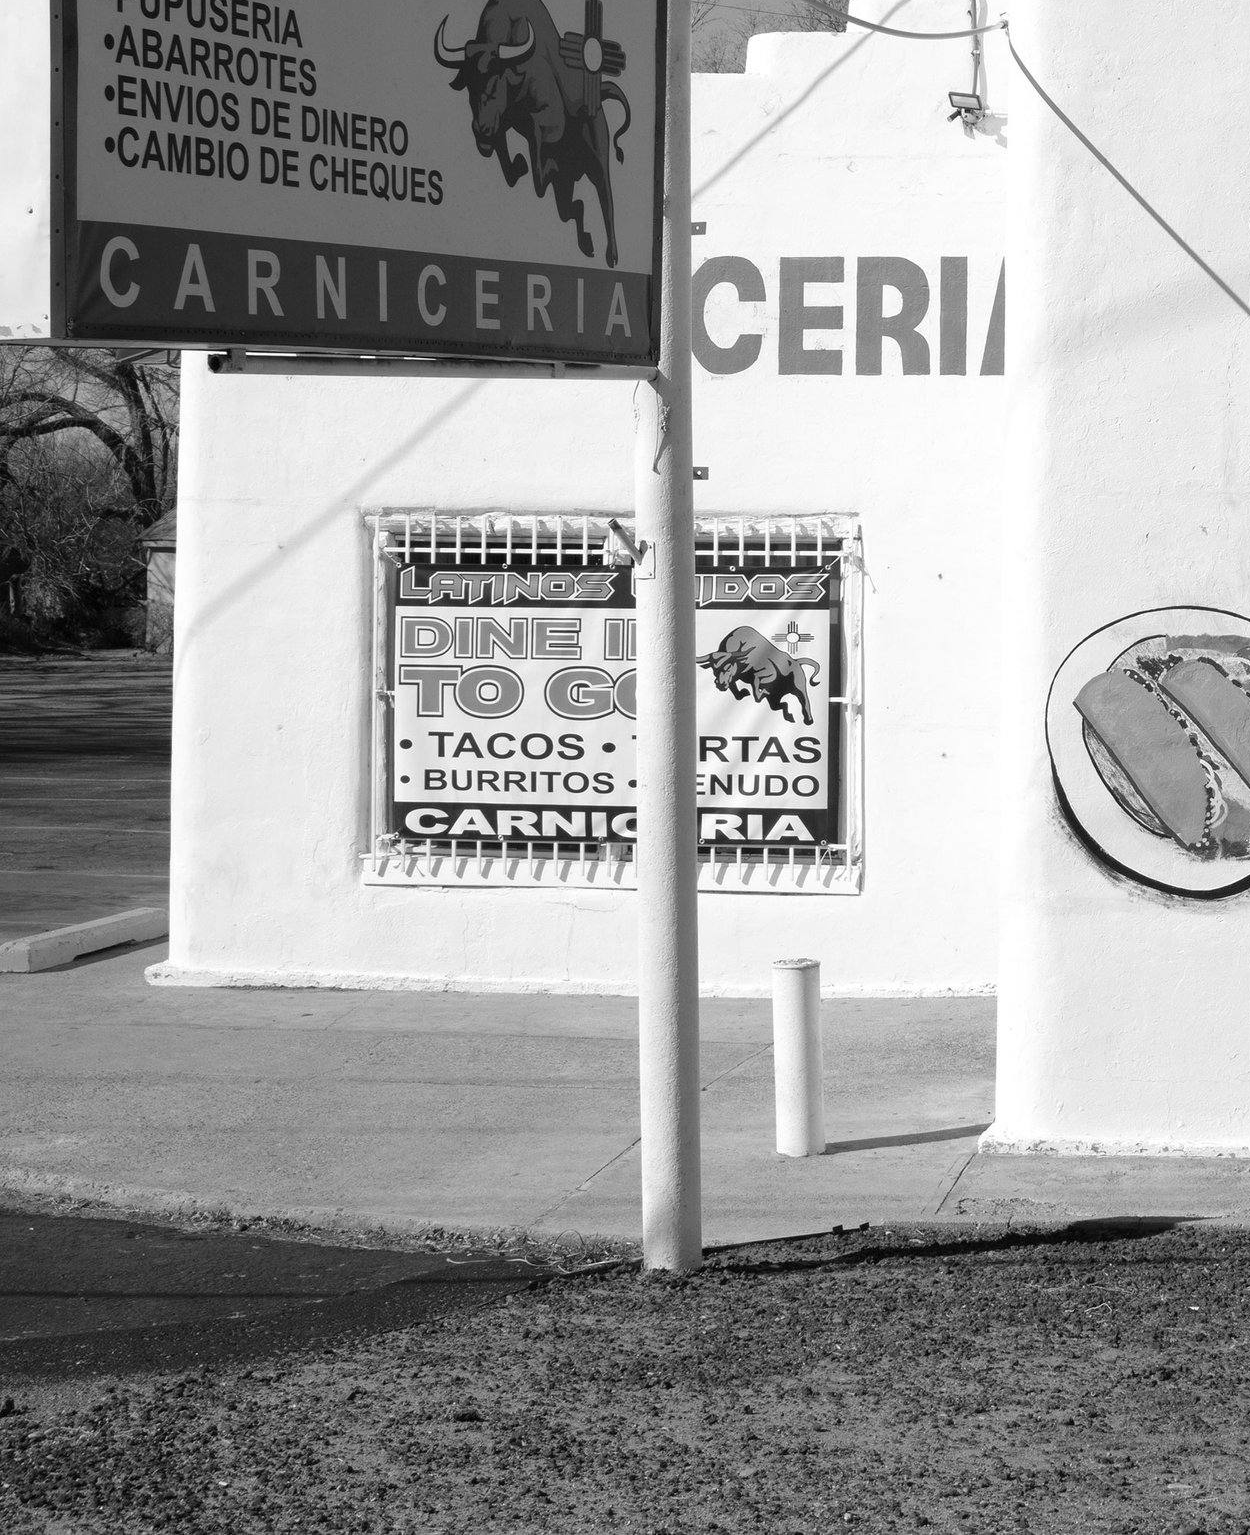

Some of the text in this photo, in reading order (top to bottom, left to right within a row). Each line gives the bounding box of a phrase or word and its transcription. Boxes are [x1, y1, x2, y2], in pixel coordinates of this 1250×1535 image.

[115, 25, 317, 97] ABARROTES
[117, 73, 409, 156] ENVIOS DE DINERO
[117, 125, 444, 206] CAMBIO DE CHEQUES
[100, 235, 632, 338] CARNICERIA
[401, 567, 829, 606] LATINOS IDOS
[399, 615, 637, 661] DINE I
[399, 664, 524, 720] TO
[428, 731, 585, 761] TACOS
[423, 769, 616, 794] BURRITOS
[404, 808, 815, 841] CARNICRIA
